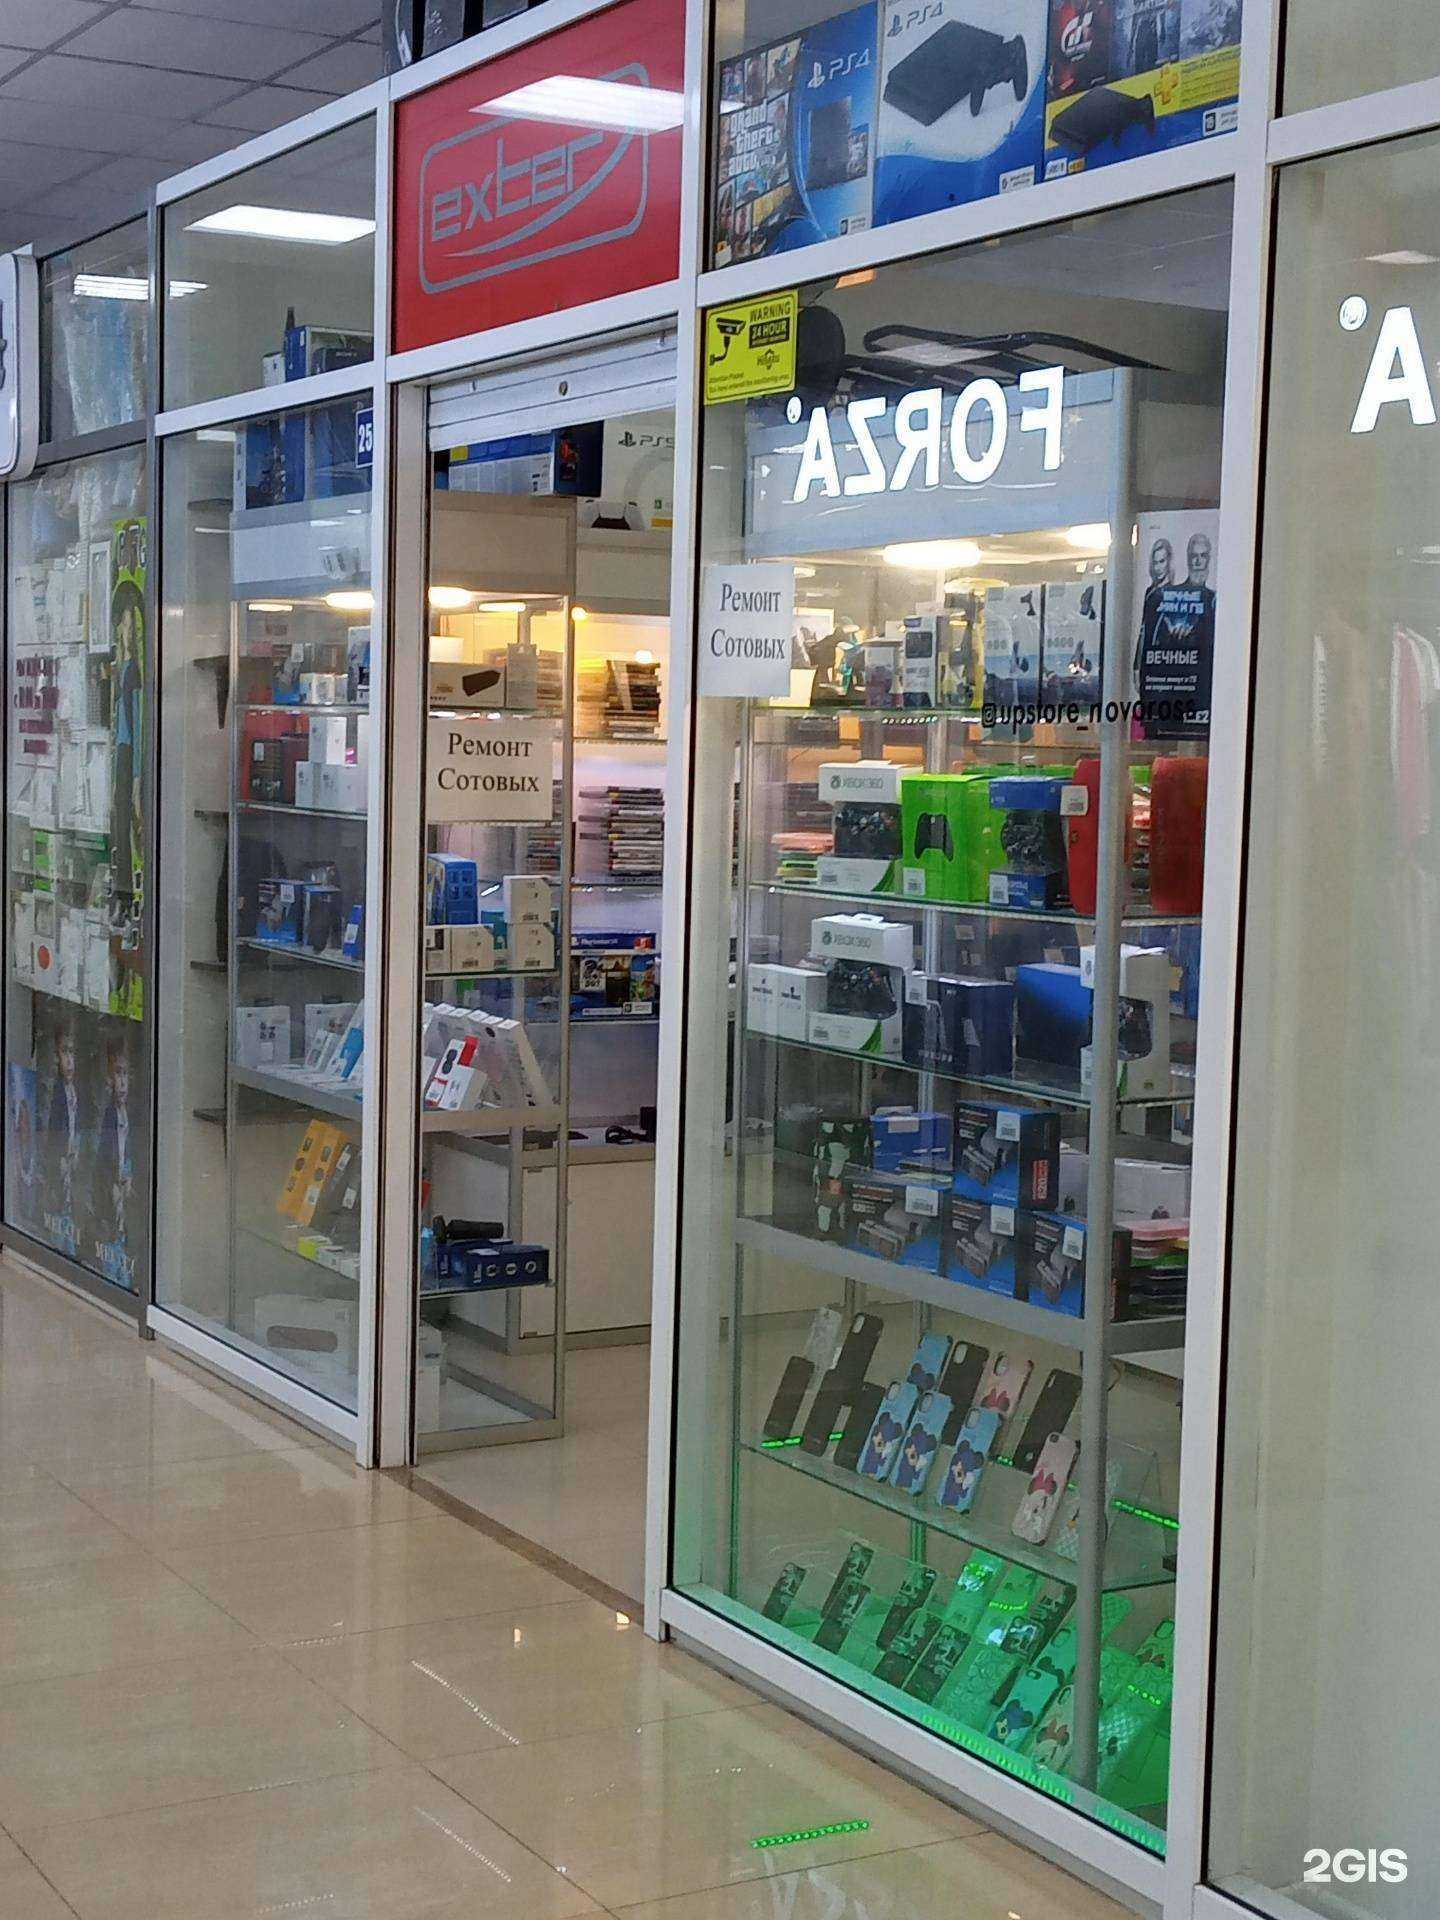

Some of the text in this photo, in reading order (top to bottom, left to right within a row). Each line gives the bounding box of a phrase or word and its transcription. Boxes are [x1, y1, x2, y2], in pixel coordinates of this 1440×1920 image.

[906, 1, 943, 29] PS4
[829, 48, 870, 80] PS4
[750, 301, 791, 322] WARNING
[752, 326, 762, 340] 24
[763, 320, 787, 337] HOUR
[720, 583, 781, 613] Ремонт
[711, 628, 785, 659] Сотовых
[1146, 650, 1199, 664] ВЕЧНЫЕ
[448, 732, 533, 757] Ремонт
[437, 767, 540, 792] Сотовых
